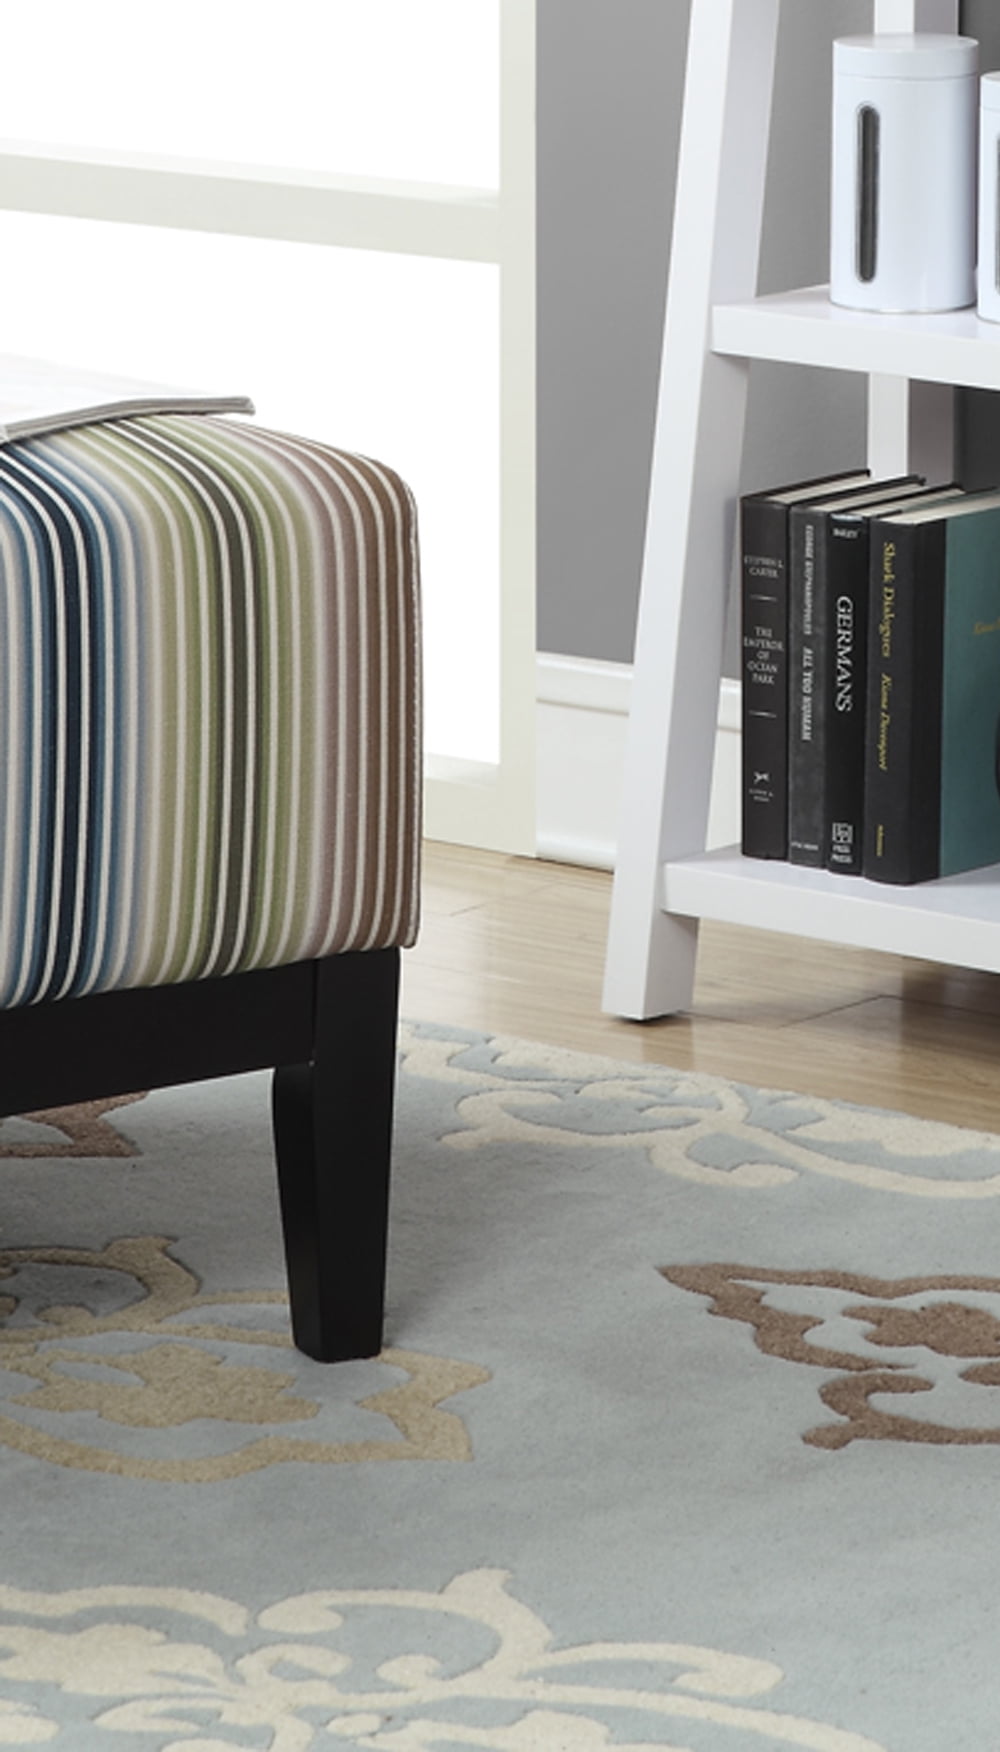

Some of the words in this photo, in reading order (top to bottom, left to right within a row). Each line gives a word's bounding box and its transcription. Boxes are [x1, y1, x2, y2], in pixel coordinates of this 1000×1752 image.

[883, 542, 896, 582] Shark
[879, 586, 896, 657] Dialogues
[802, 646, 814, 668] ALL
[836, 596, 853, 711] GERMANS
[801, 696, 813, 740] HUMAN
